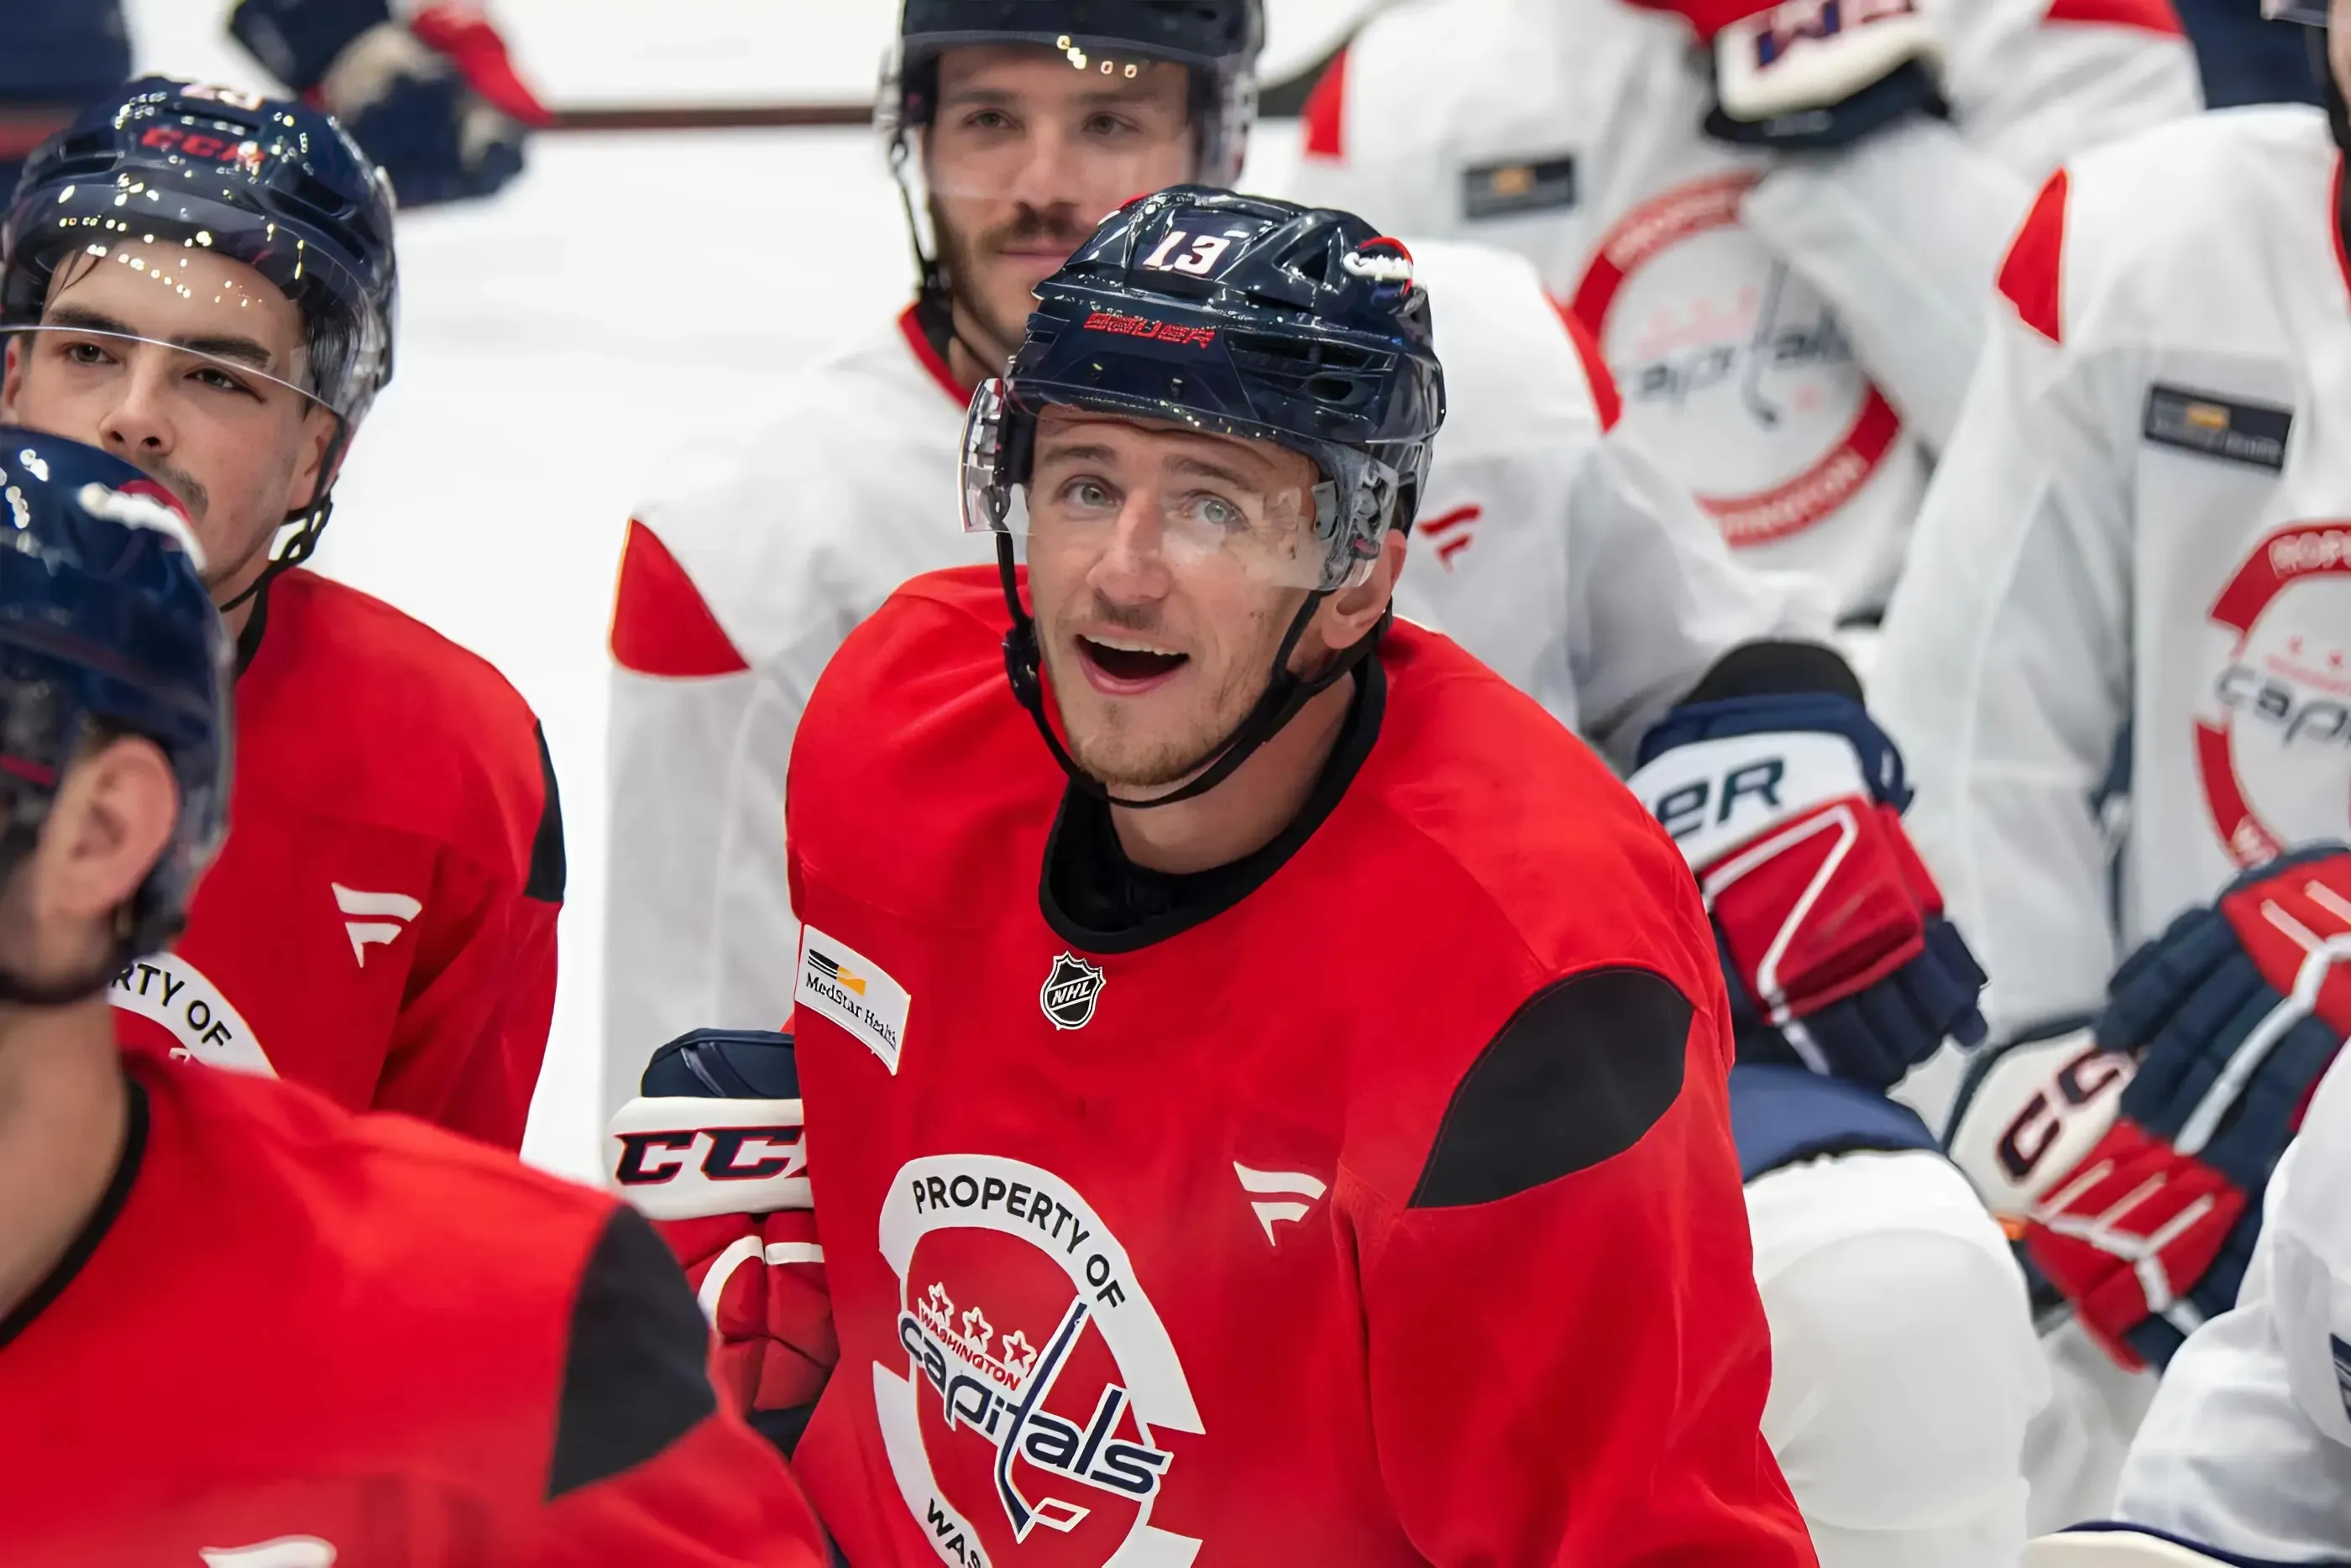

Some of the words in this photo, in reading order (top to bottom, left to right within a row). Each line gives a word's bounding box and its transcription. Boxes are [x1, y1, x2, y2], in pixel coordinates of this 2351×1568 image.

[1142, 231, 1231, 274] 13
[806, 971, 862, 1017] MedStar
[1051, 980, 1092, 1006] NHL
[186, 999, 232, 1047] OF
[614, 1125, 808, 1186] CC
[912, 1174, 1090, 1255] PROPERTY
[1086, 1253, 1126, 1308] OF
[920, 1301, 1022, 1392] WASHINGTON
[900, 1301, 1167, 1528] capitals
